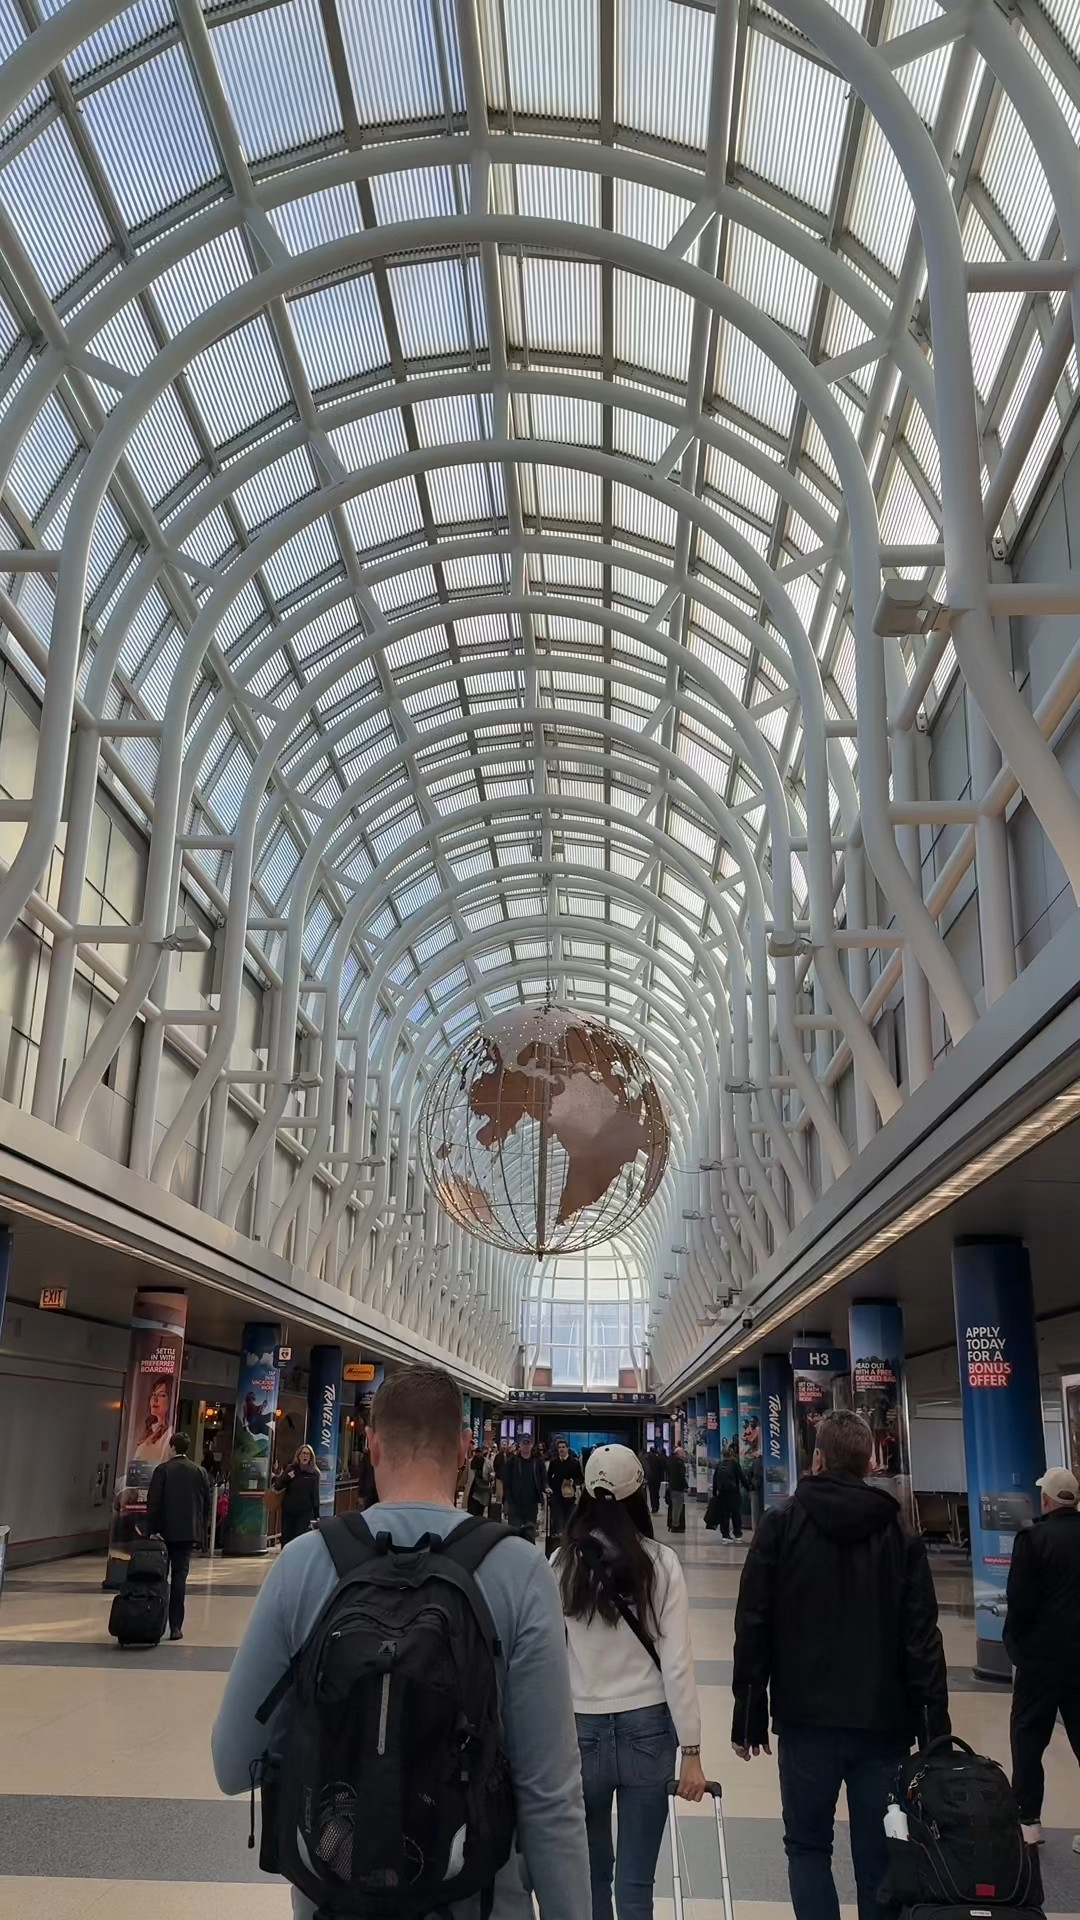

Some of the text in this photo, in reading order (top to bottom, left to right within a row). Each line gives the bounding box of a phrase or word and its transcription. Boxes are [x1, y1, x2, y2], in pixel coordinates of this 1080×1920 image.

[43, 1289, 62, 1303] EXIT
[966, 1326, 1000, 1338] APPLY
[966, 1338, 1006, 1350] TODAY
[809, 1352, 829, 1366] H3
[968, 1351, 1003, 1362] FOR A
[968, 1362, 1011, 1373] BONUS
[969, 1374, 1008, 1386] OFFER
[321, 1383, 336, 1448] TRAVEL ON
[768, 1394, 782, 1460] TRAVEL ON
